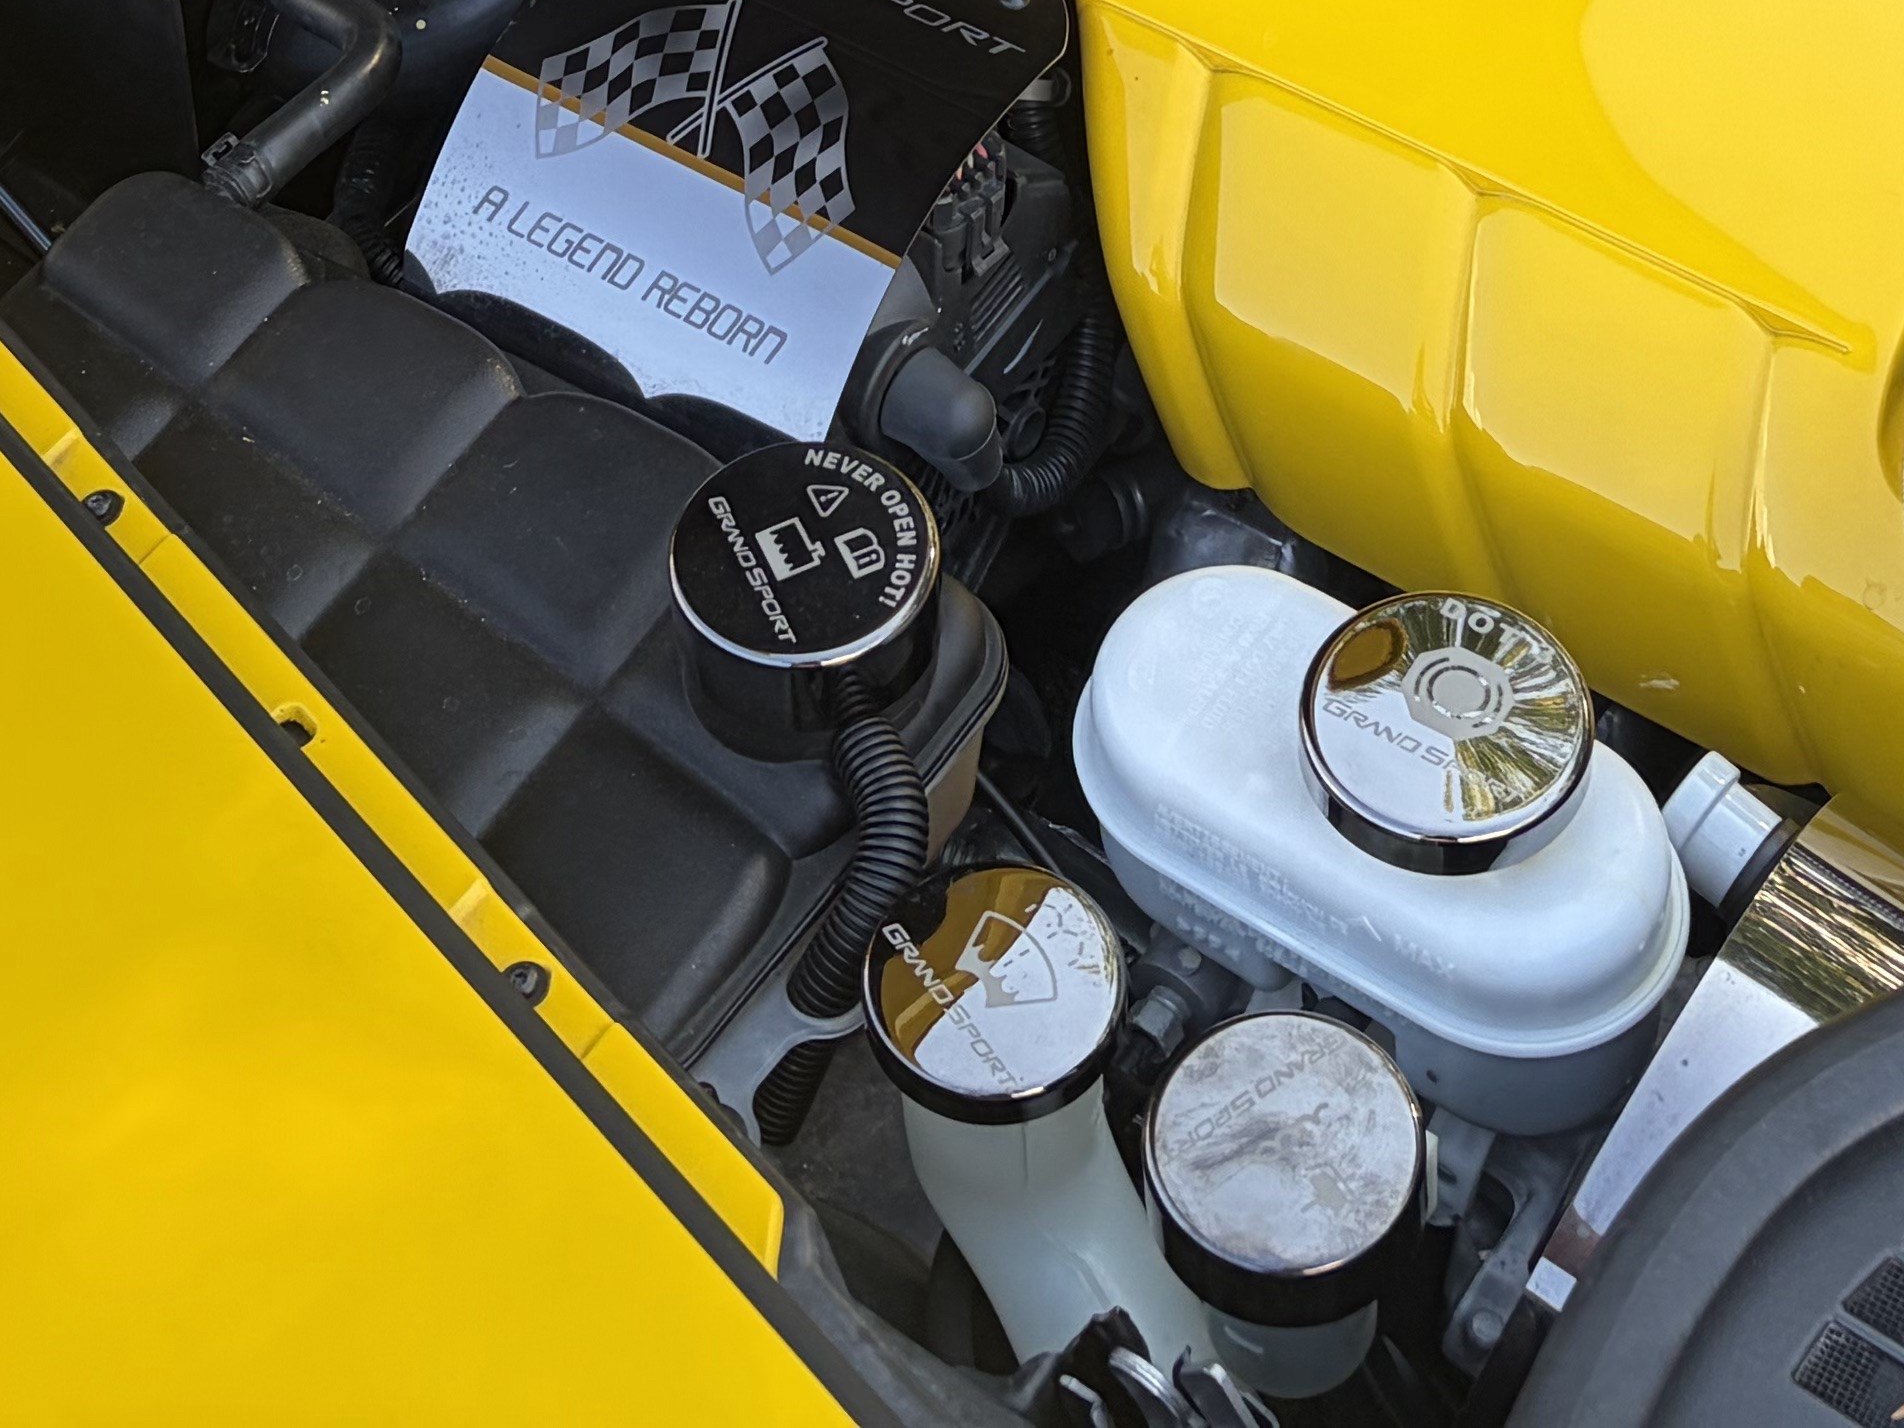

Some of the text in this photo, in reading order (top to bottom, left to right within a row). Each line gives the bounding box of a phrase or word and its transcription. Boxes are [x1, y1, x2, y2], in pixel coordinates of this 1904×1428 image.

[472, 185, 789, 365] A LEGEND REBORN
[708, 496, 797, 644] GRAND SPORT
[804, 448, 917, 608] NEVER OPEN HOT!
[1440, 598, 1525, 646] DOT
[1322, 698, 1421, 753] GRAND
[882, 923, 1021, 1090] GRAND SPORT
[1166, 1035, 1349, 1160] GRAND SPORT
